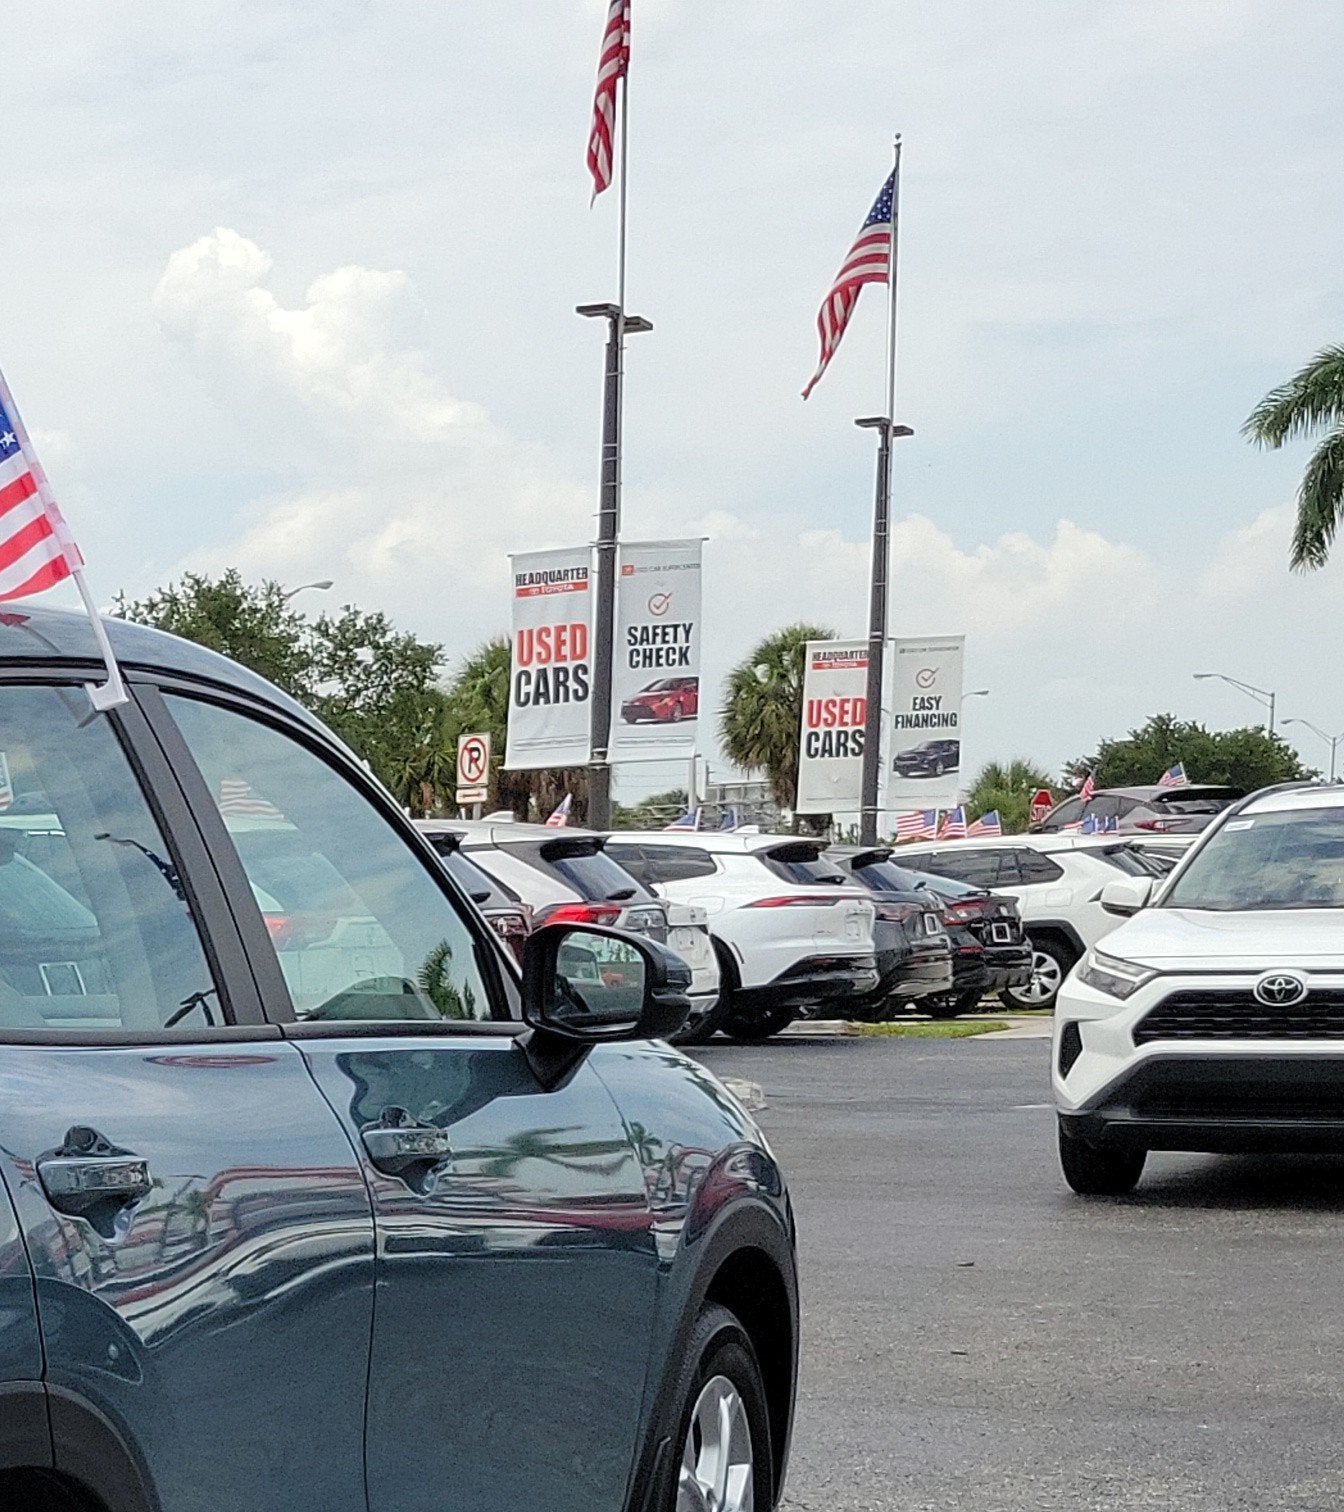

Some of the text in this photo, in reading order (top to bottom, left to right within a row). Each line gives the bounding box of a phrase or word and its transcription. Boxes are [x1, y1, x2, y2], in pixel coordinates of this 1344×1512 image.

[515, 567, 588, 587] HEADQUARTER
[516, 623, 588, 667] USED
[627, 622, 693, 647] SAFETY
[628, 645, 691, 669] CHECK
[514, 663, 589, 708] CARS
[807, 697, 867, 728] USED
[912, 696, 943, 712] EASY
[894, 713, 958, 729] FINANCING
[806, 729, 866, 759] CARS
